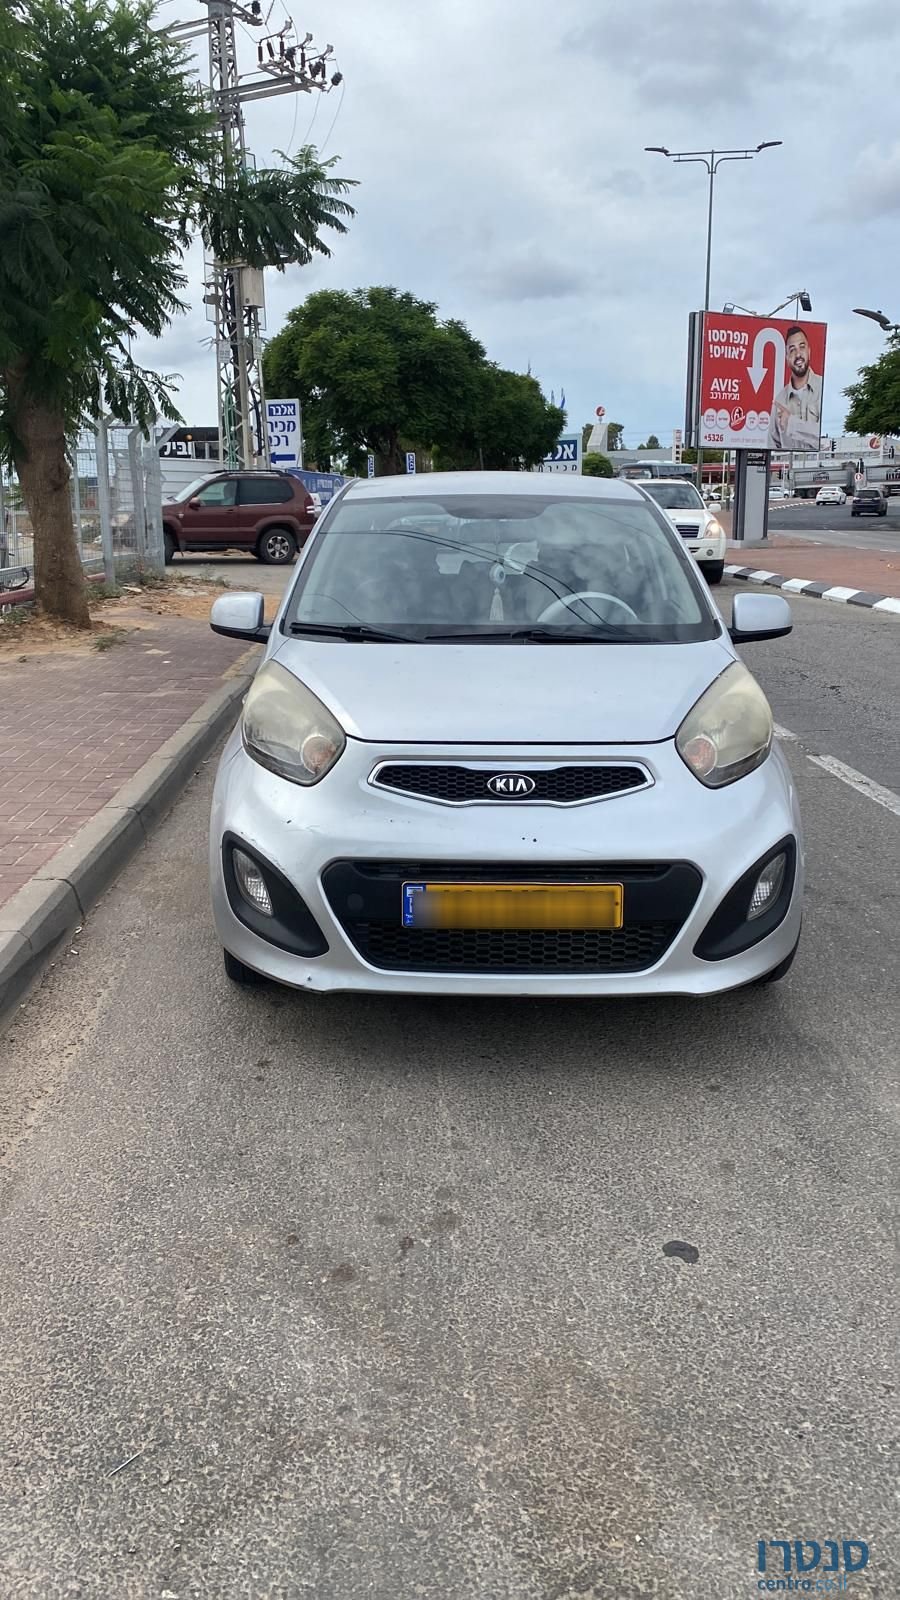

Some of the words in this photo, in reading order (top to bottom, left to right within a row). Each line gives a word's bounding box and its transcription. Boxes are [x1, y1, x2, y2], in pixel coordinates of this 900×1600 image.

[708, 329, 749, 346] תפרססו
[709, 344, 747, 361] לאוויס!
[710, 378, 739, 393] AVIS
[269, 405, 295, 416] אלבר
[495, 778, 528, 792] KIA
